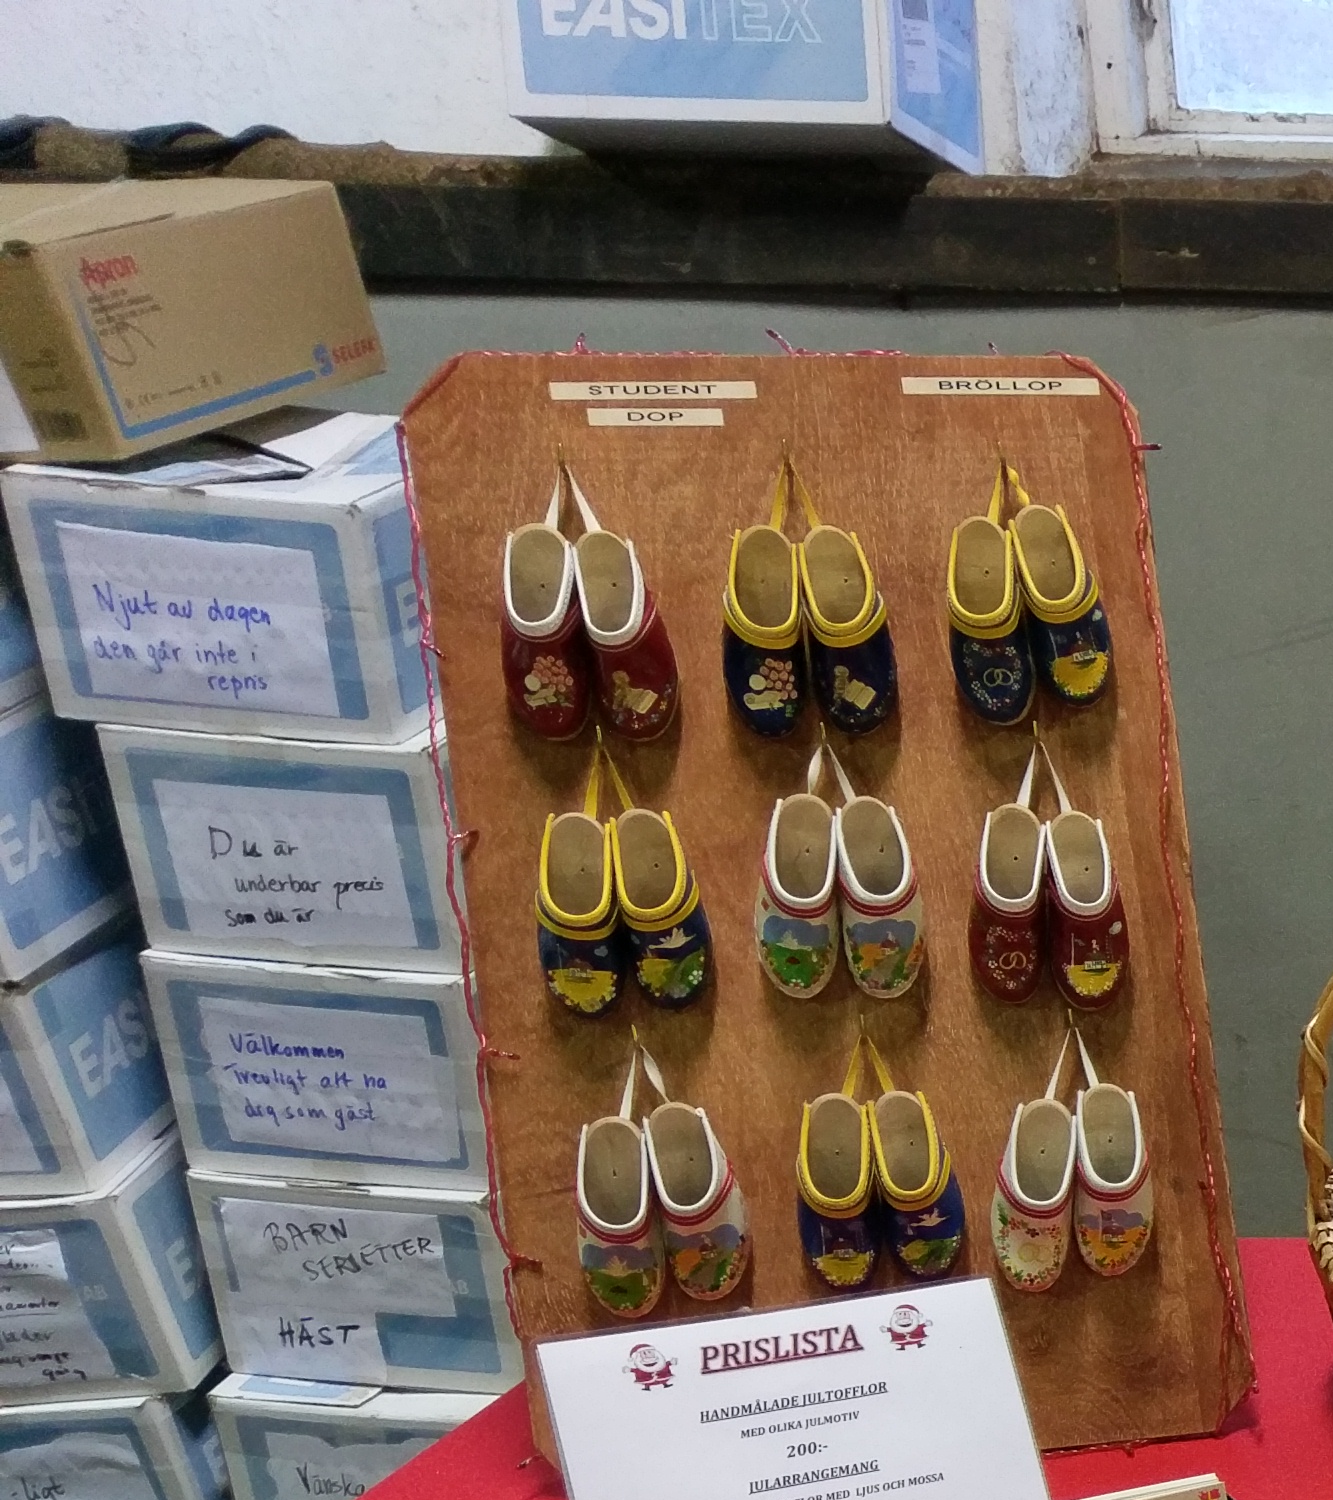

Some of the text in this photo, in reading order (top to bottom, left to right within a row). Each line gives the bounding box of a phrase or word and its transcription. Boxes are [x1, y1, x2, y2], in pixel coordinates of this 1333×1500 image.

[588, 384, 717, 396] STUDENT
[938, 379, 1063, 391] BRÖLLOP
[626, 411, 684, 422] DOP
[92, 581, 271, 631] Njut av dagen
[93, 636, 257, 674] den går inte i
[274, 840, 299, 857] är
[234, 874, 384, 911] underbar precis
[229, 1033, 345, 1059] Välkommen
[320, 1071, 353, 1089] att
[244, 1097, 376, 1131] dig som gäst
[263, 1218, 349, 1253] BARN
[278, 1316, 360, 1348] HÄST
[700, 1324, 865, 1373] PRISLISTA
[700, 1381, 888, 1423] HANDMÅLADE JULTOFFLOR
[741, 1411, 860, 1439] MED OLIKA JULMOTIV
[786, 1441, 828, 1458] 200:-
[749, 1460, 880, 1494] JULARRANGEMANG
[826, 1489, 850, 1500] MED
[856, 1484, 880, 1498] LJUS
[882, 1479, 905, 1491] OCH
[908, 1472, 945, 1487] MOSSA
